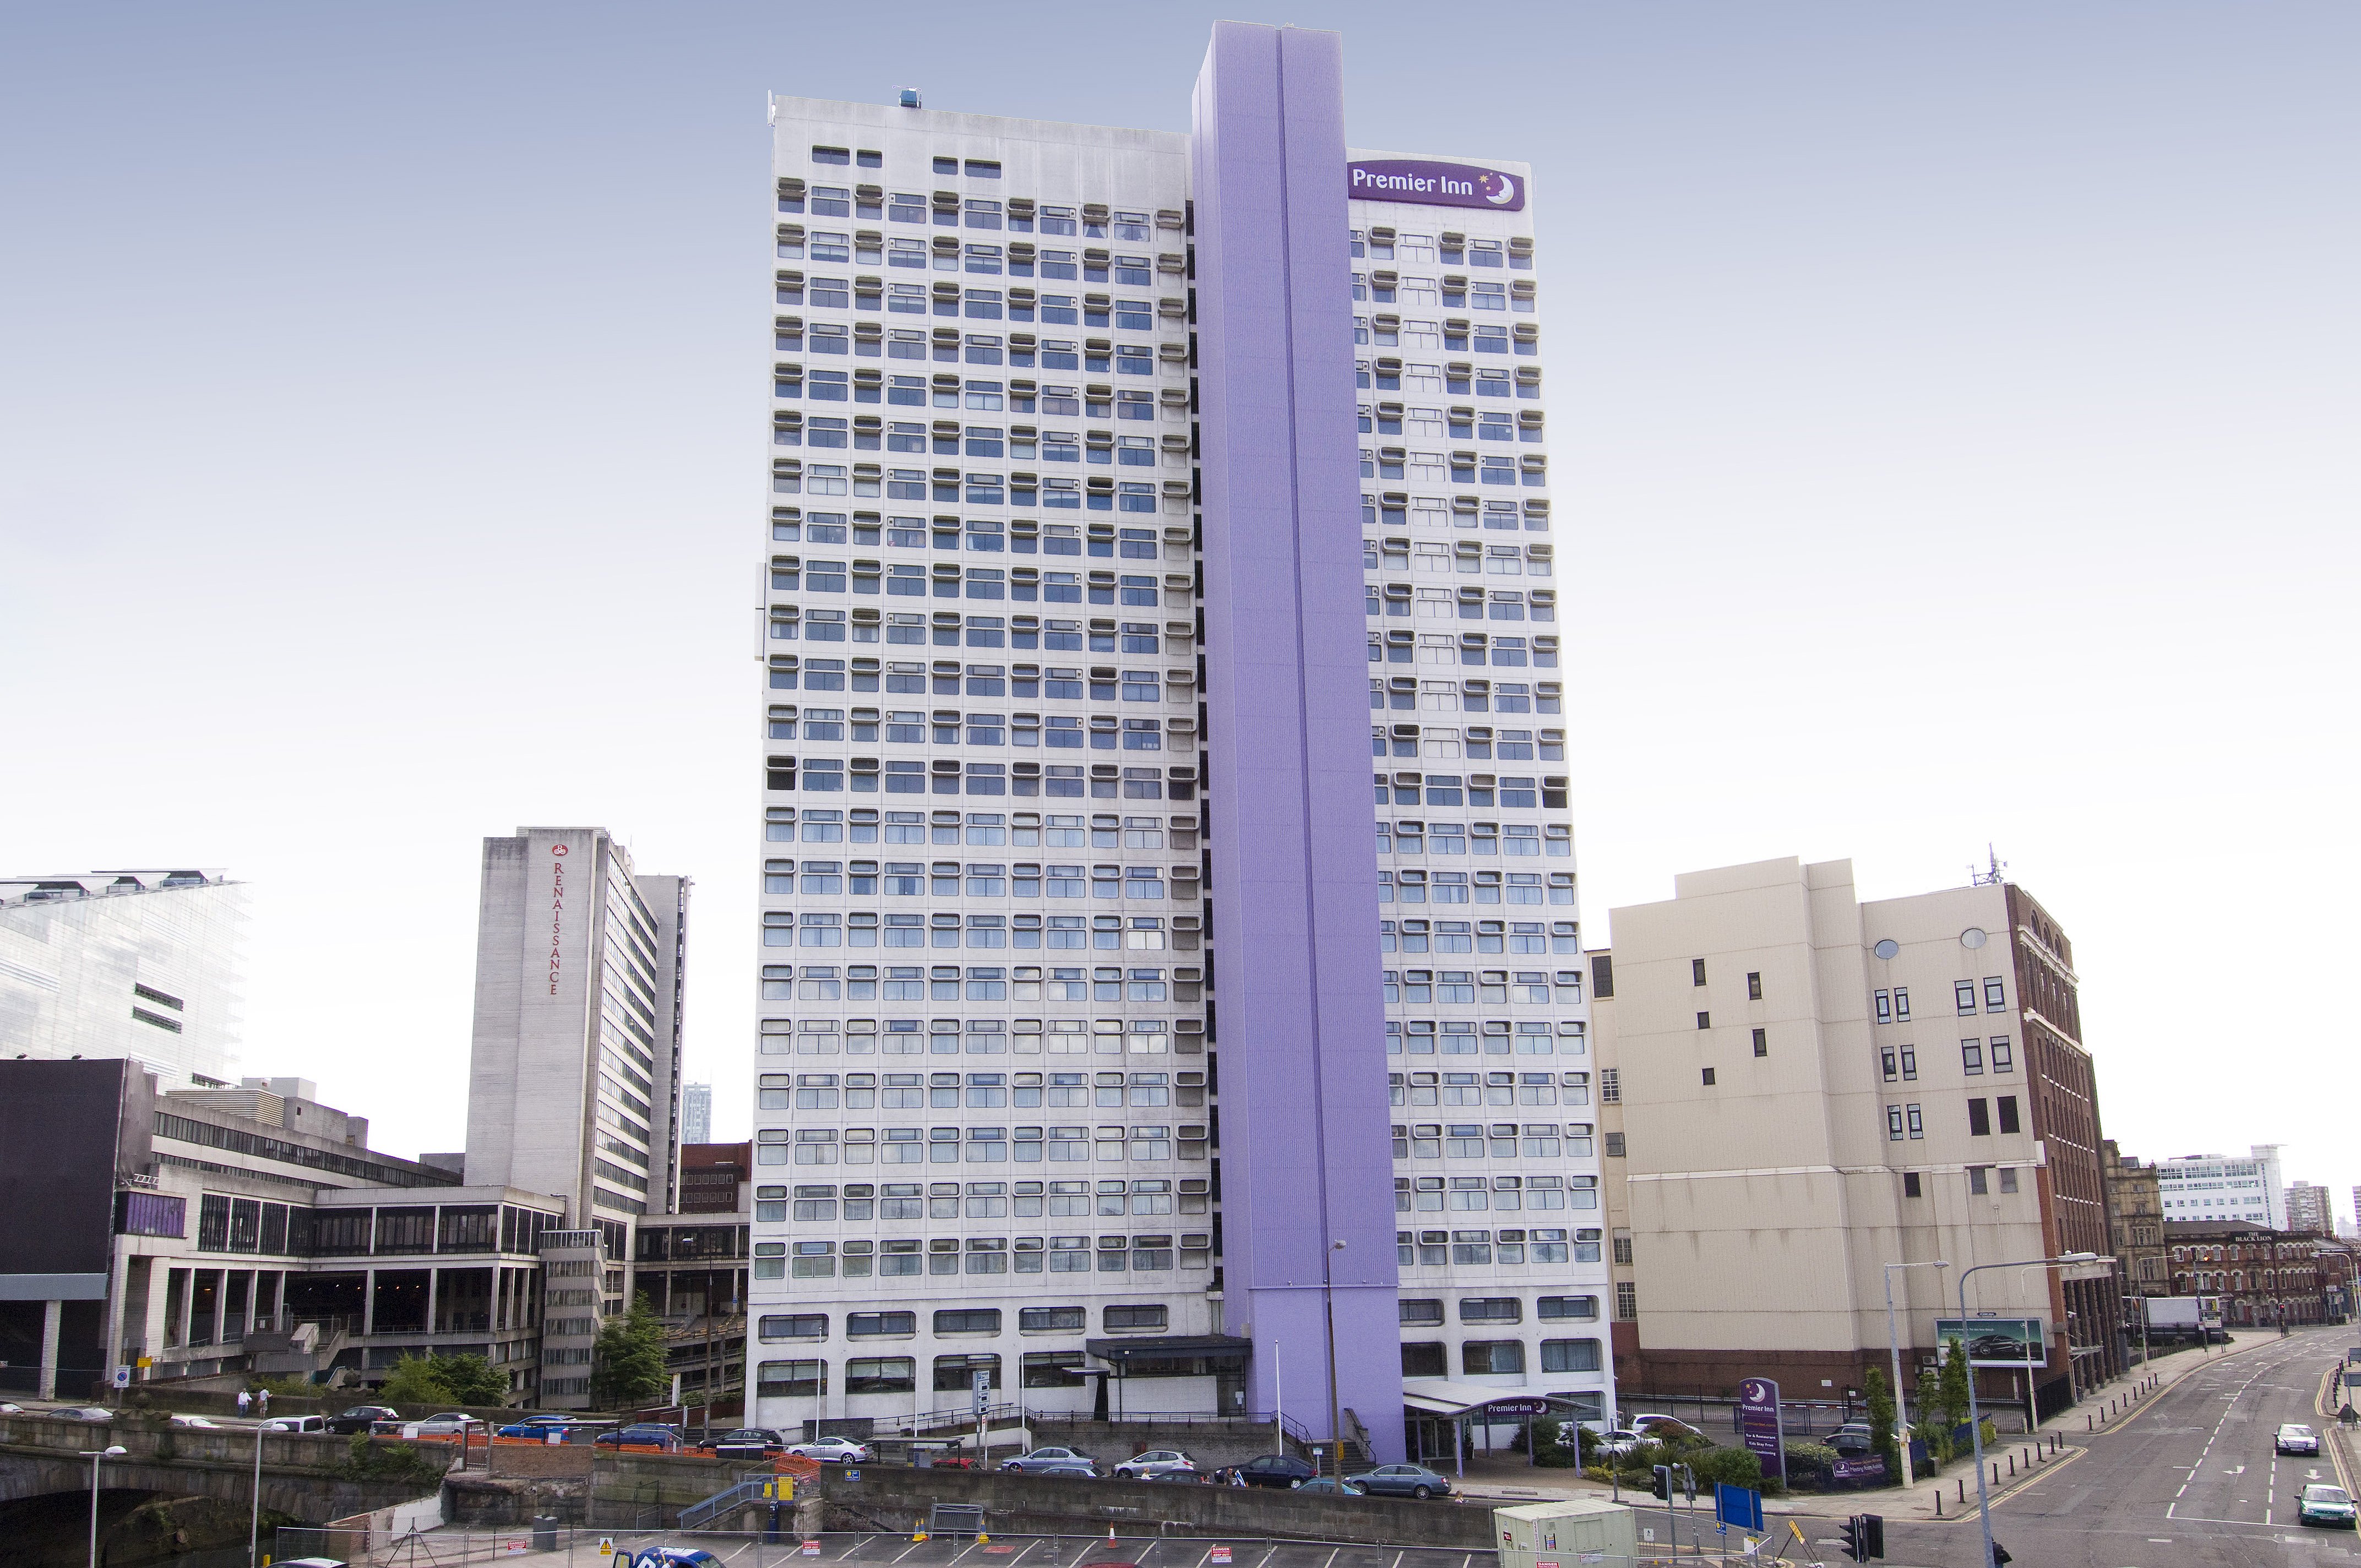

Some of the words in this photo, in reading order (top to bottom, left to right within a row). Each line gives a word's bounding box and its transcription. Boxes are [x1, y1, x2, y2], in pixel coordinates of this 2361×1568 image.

[1353, 168, 1436, 192] Premier
[1441, 176, 1473, 195] Inn
[550, 863, 564, 995] RENAISSANCE
[1488, 1404, 1519, 1412] Premier
